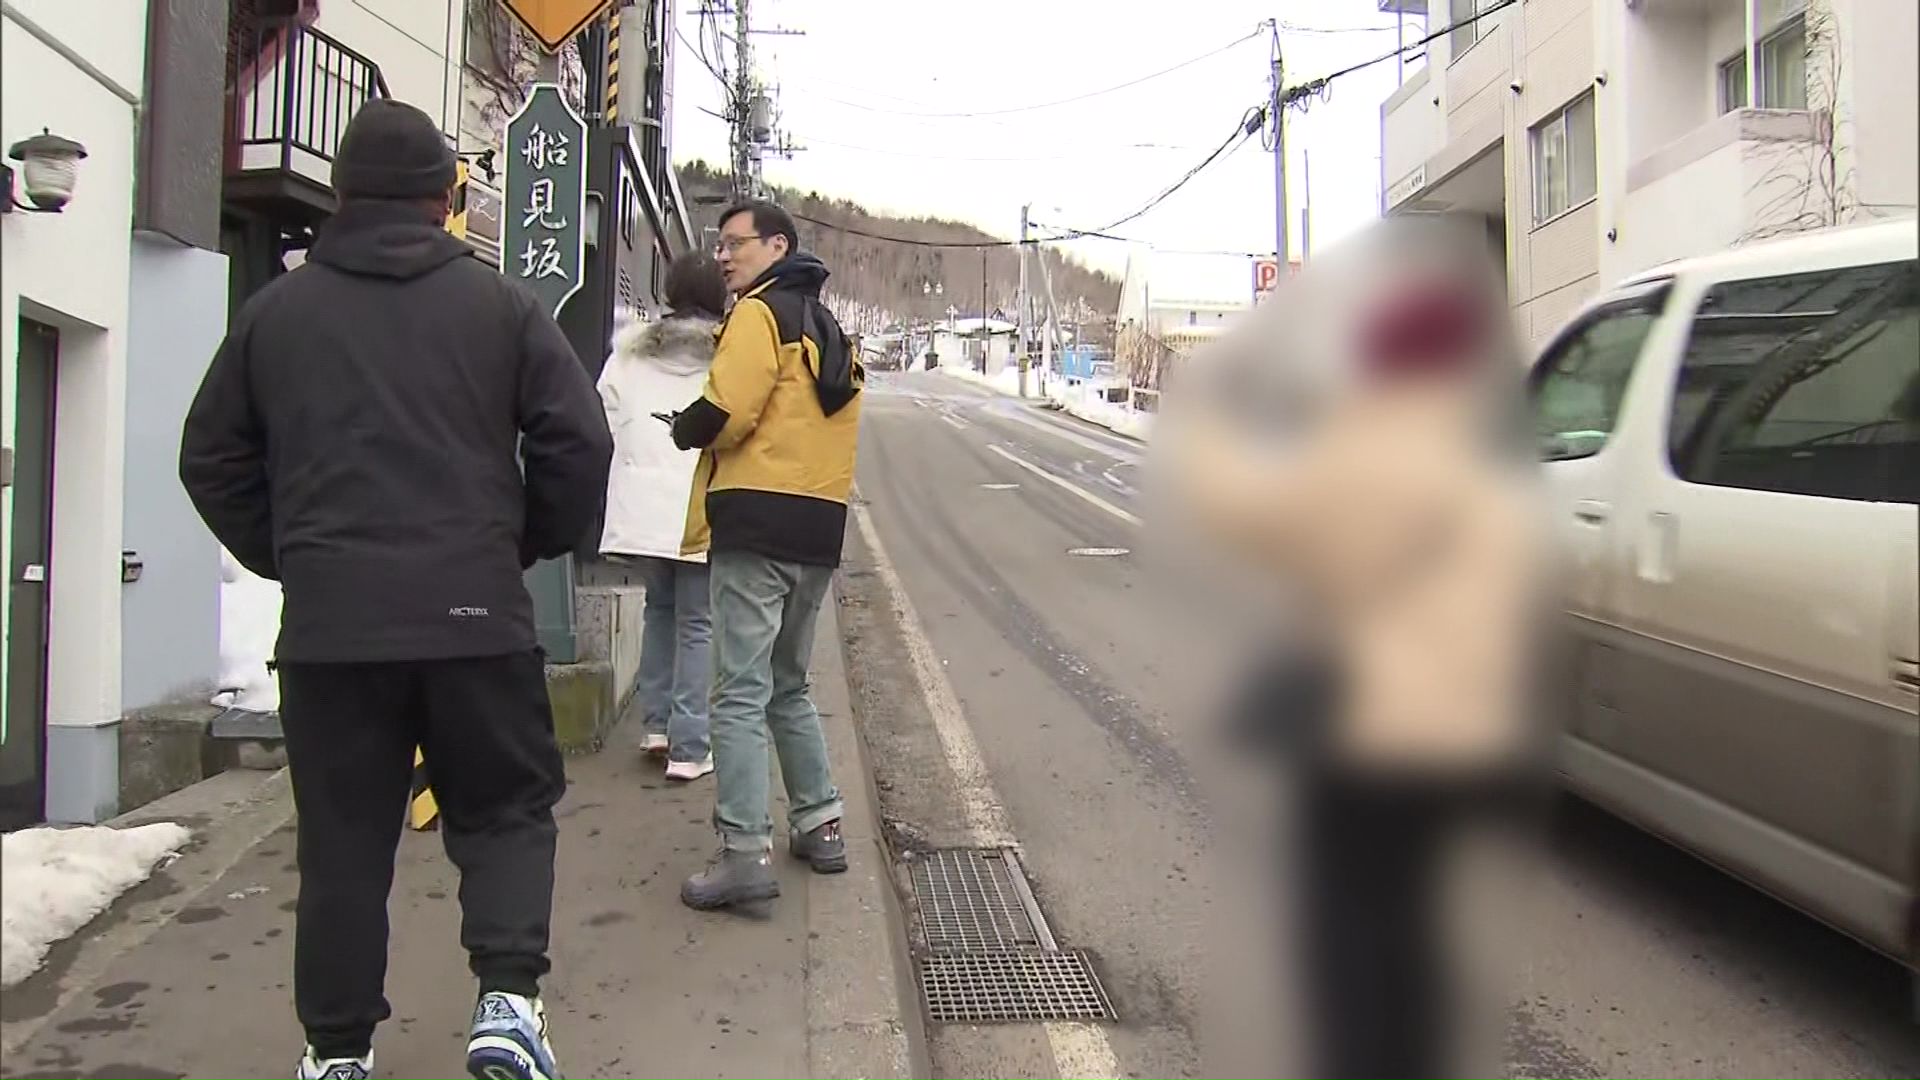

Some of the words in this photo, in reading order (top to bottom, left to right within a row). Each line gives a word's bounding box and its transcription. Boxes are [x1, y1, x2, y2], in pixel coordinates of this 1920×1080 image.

[520, 122, 569, 280] 船見坂
[1261, 265, 1276, 289] P
